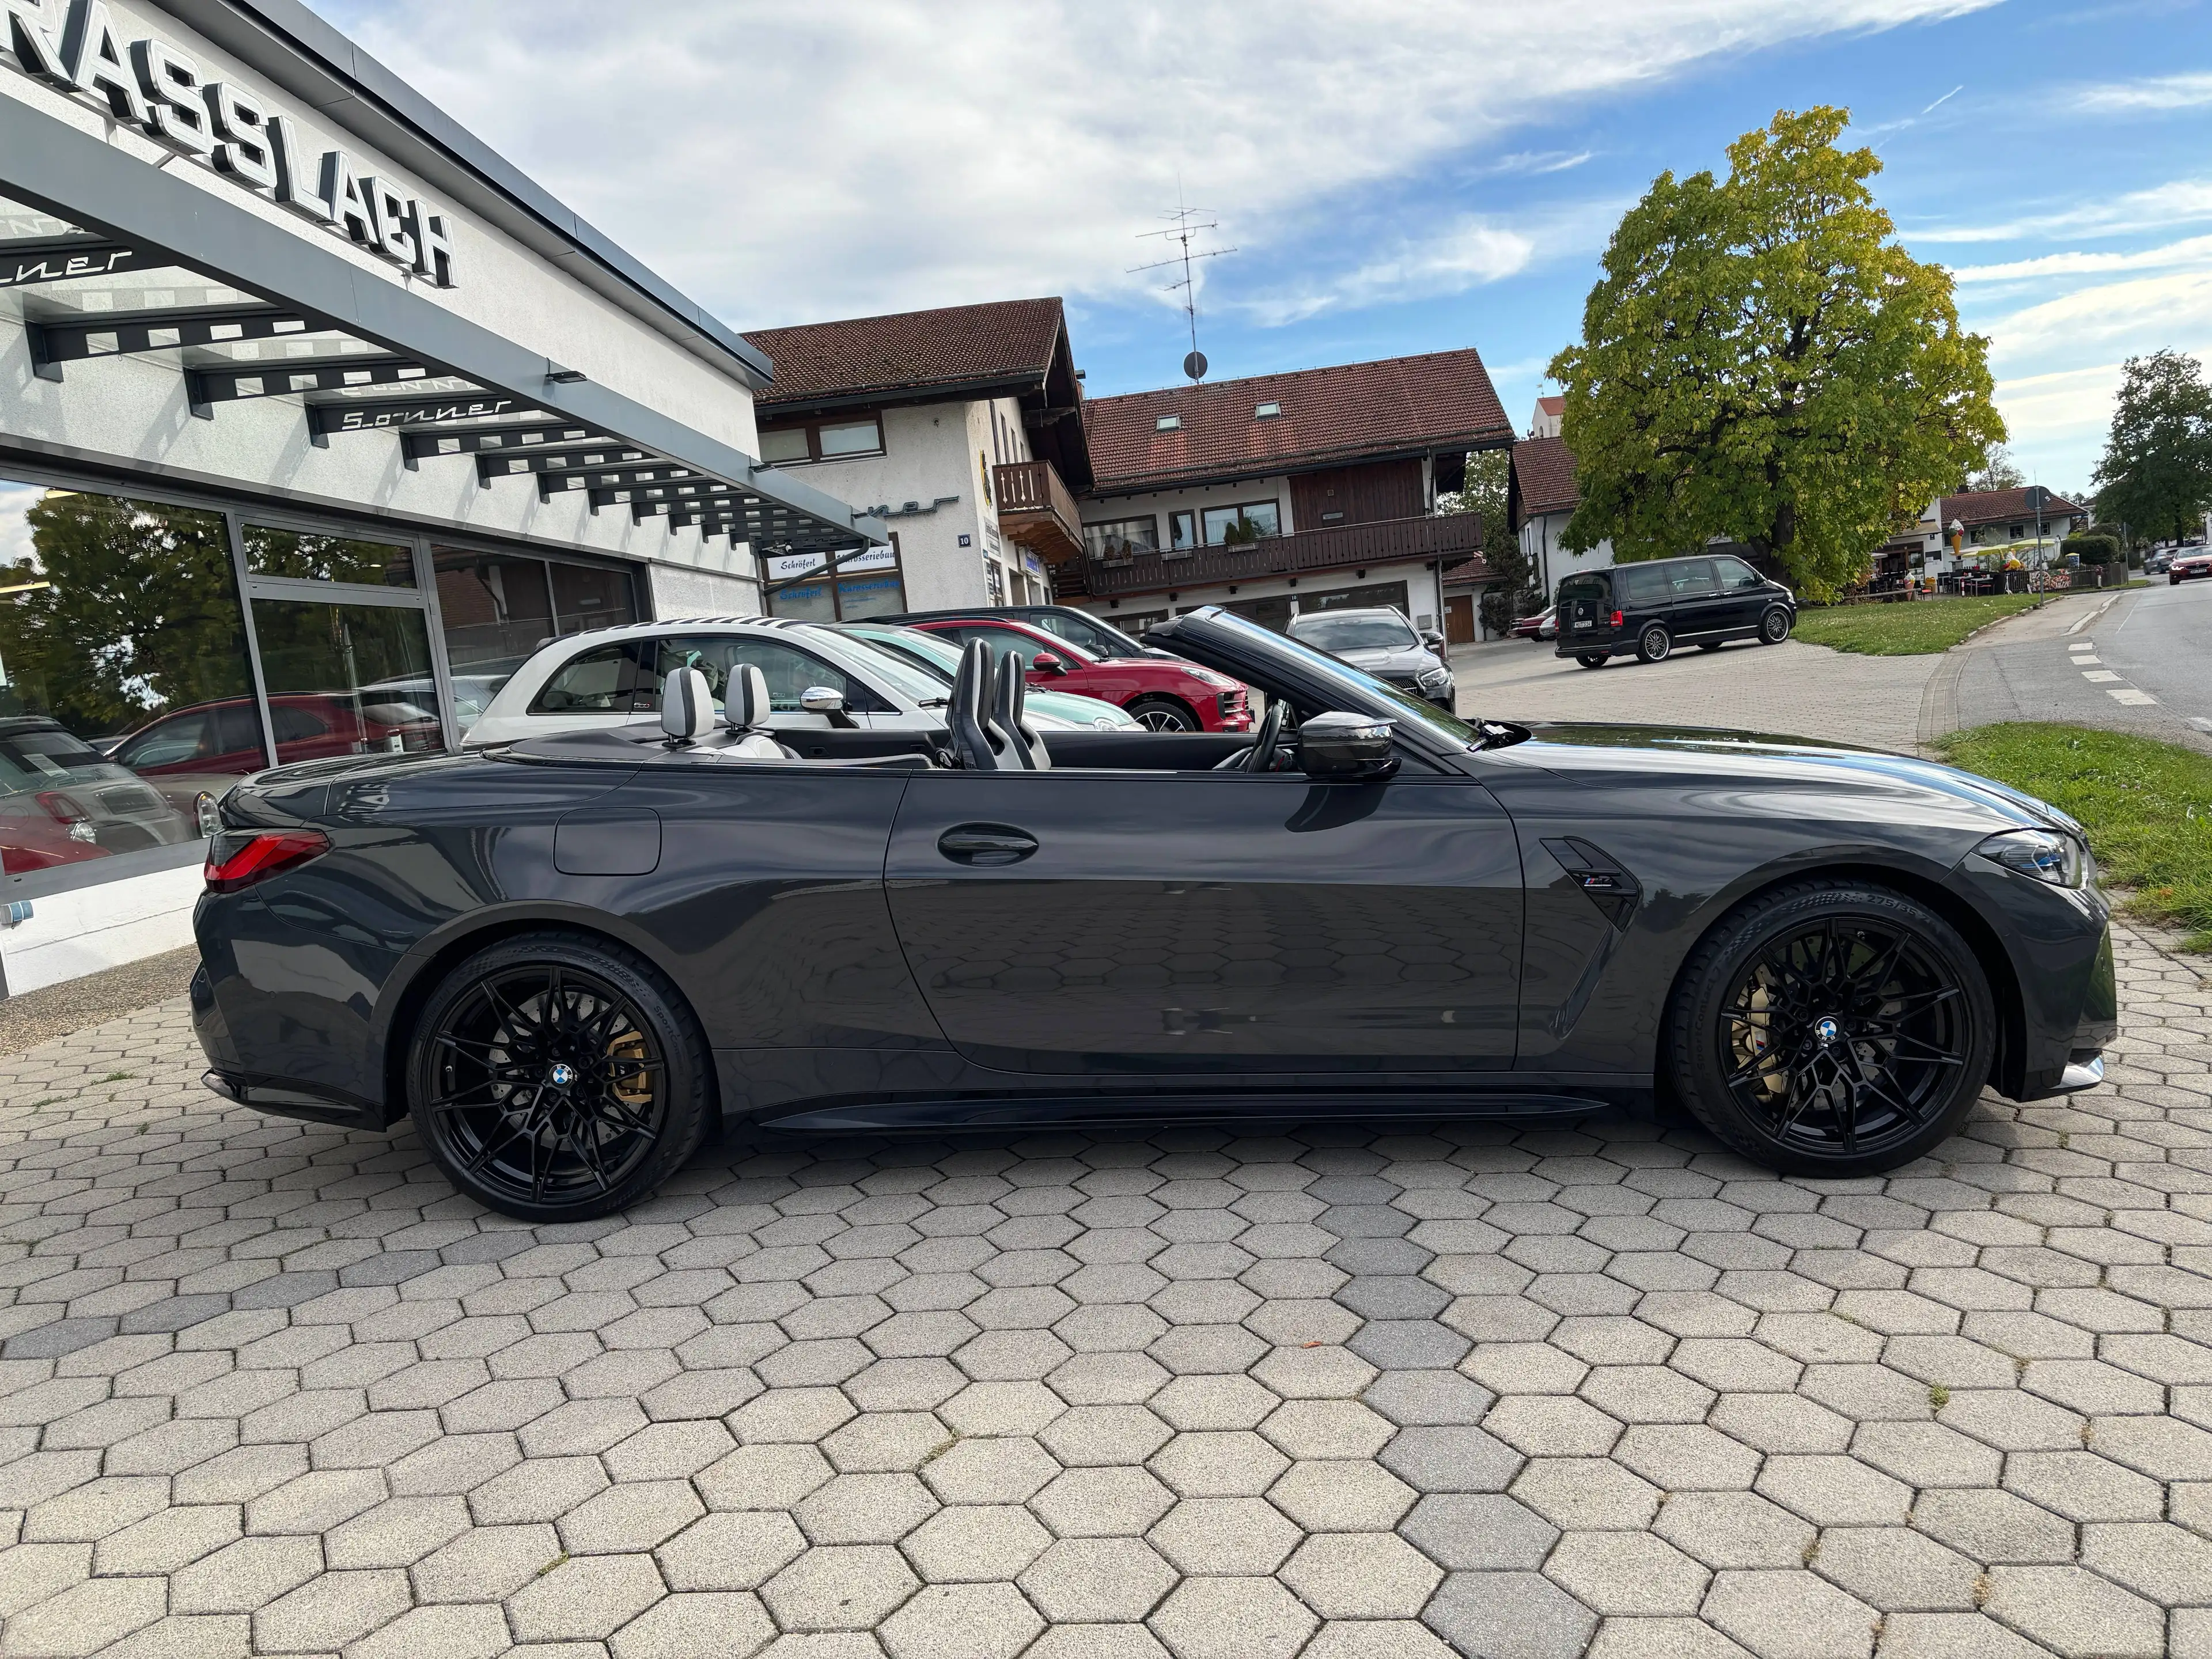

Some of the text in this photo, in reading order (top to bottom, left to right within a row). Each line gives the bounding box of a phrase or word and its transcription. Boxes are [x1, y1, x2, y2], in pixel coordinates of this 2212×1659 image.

[0, 251, 132, 283] ner
[342, 400, 512, 441] Sonner
[781, 558, 816, 570] Schröferl
[1868, 894, 1917, 915] 275/35
